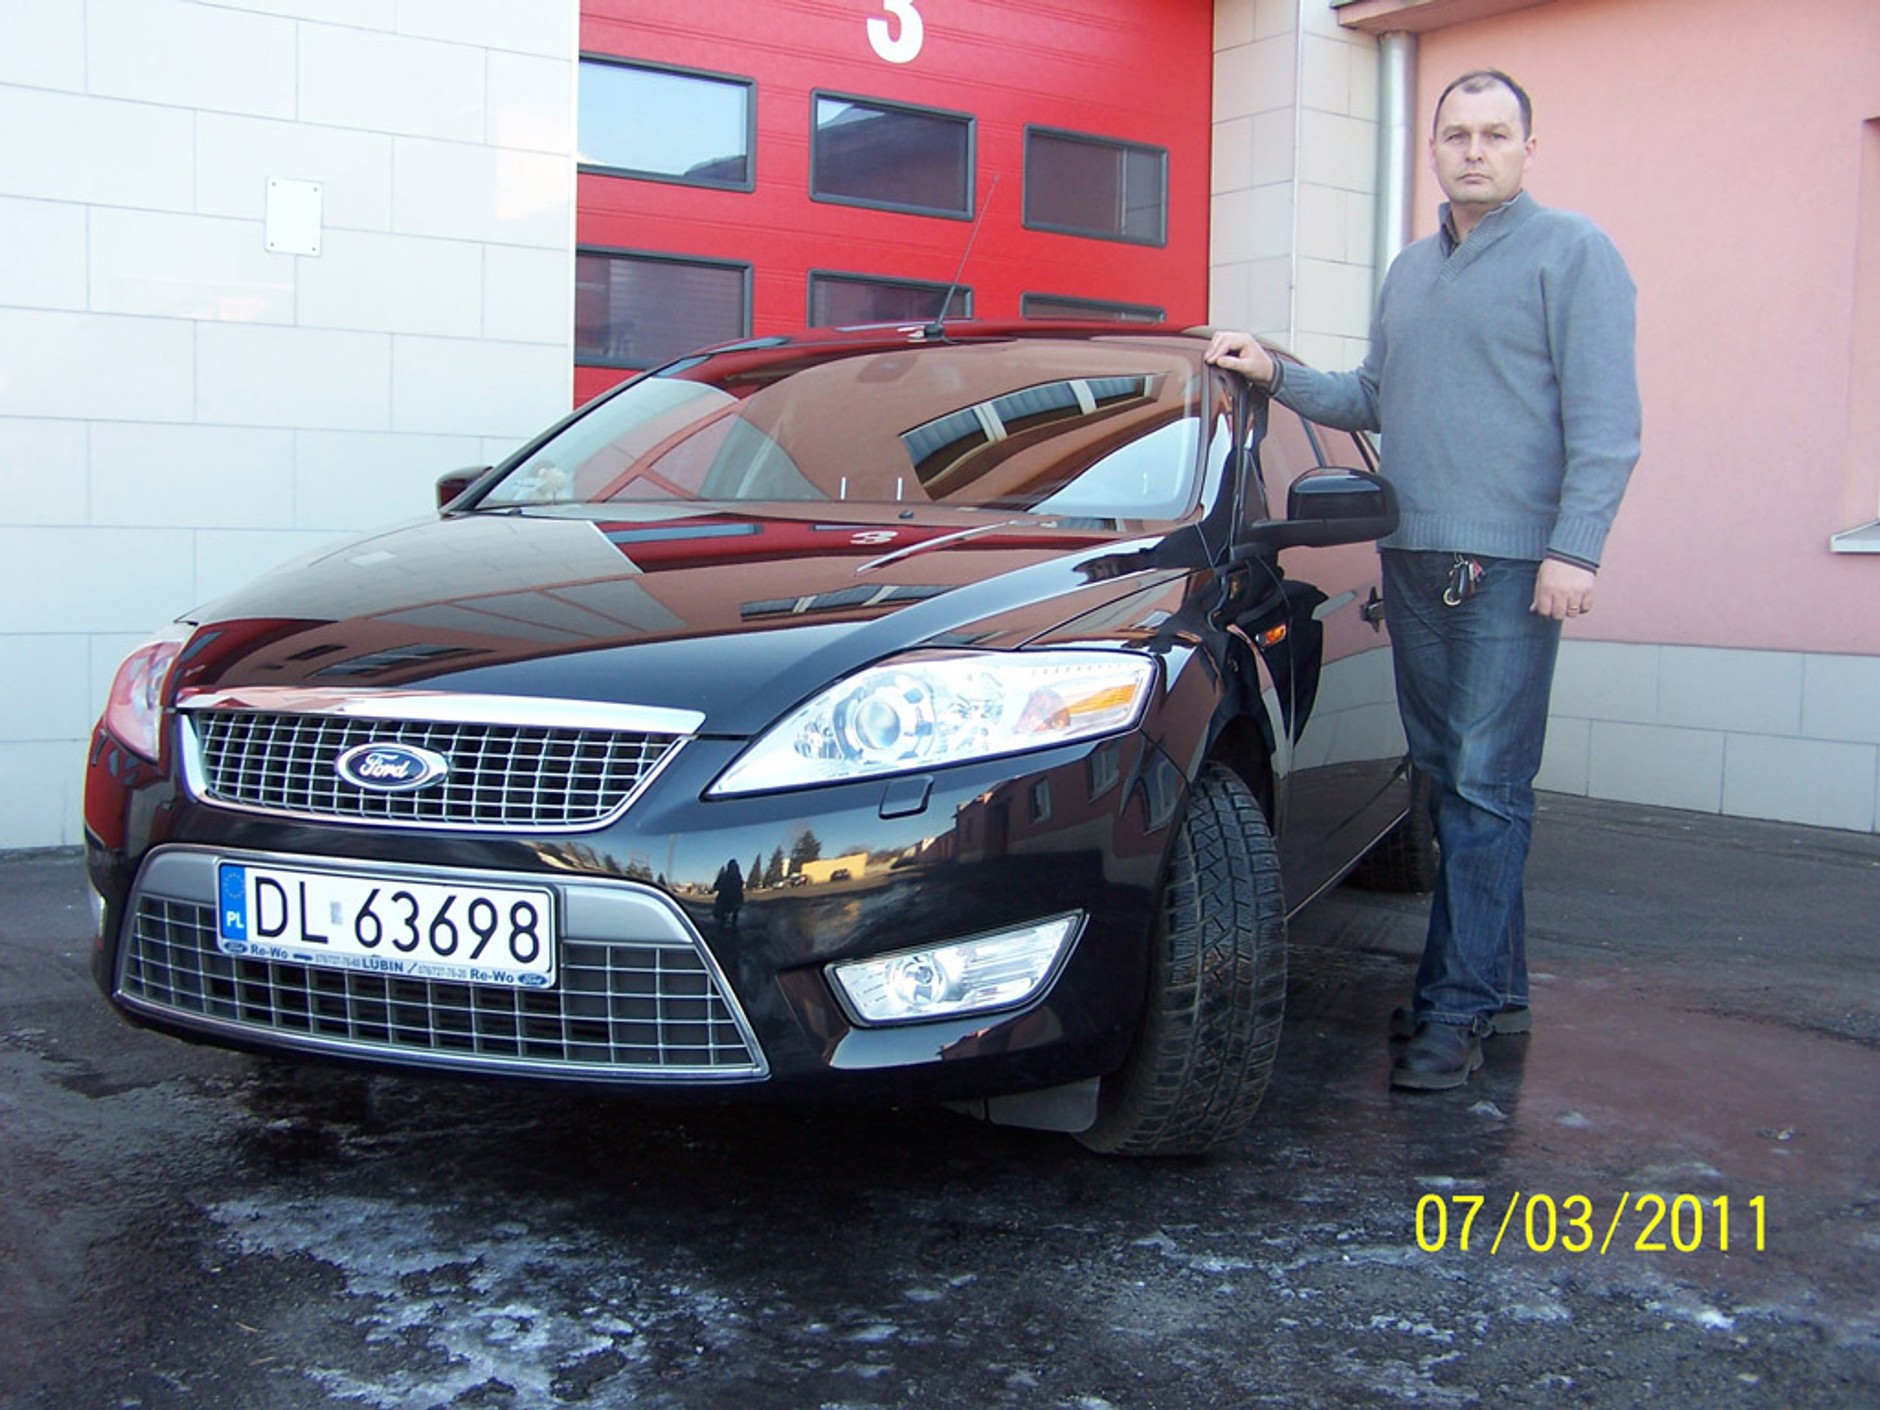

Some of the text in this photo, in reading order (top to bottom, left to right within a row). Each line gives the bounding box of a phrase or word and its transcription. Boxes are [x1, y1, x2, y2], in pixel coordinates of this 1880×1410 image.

[359, 752, 411, 779] Ford
[226, 910, 246, 929] PL
[255, 876, 541, 963] DL 63698
[250, 943, 289, 960] Re-Wo
[361, 957, 404, 973] LUBIN
[469, 968, 515, 984] Re-Wo
